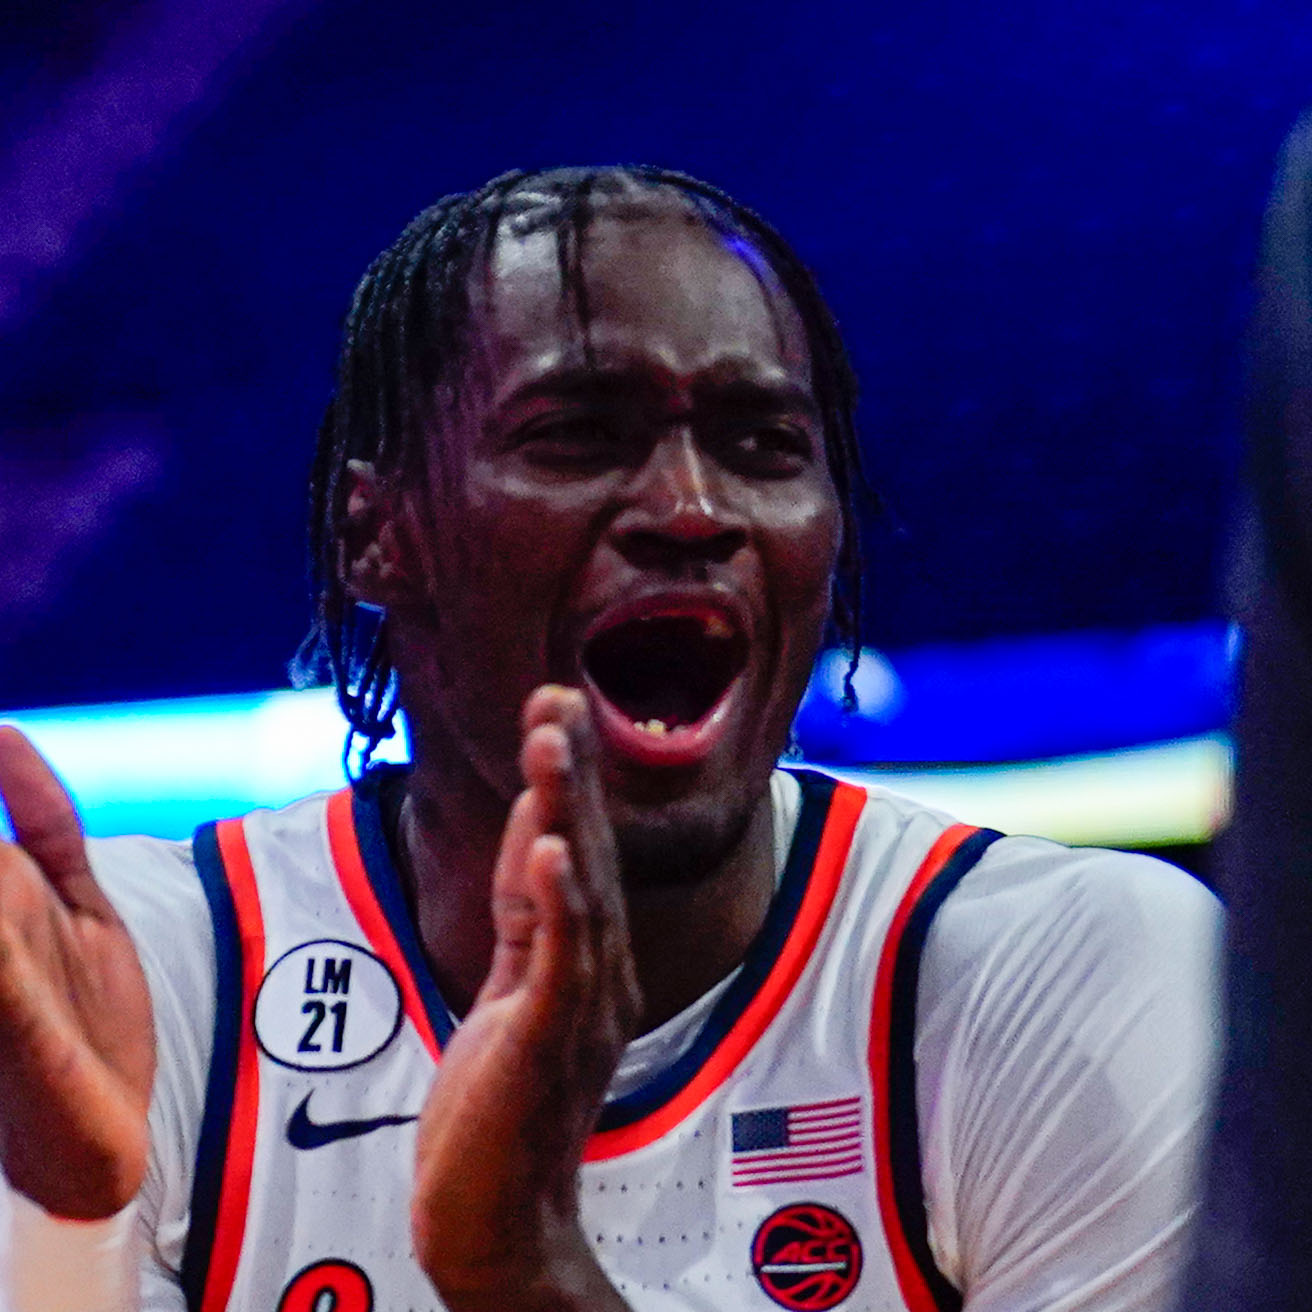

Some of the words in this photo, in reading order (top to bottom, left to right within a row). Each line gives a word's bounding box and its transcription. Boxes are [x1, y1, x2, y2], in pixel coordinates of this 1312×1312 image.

[304, 958, 352, 994] LM
[297, 1000, 347, 1053] 21
[770, 1239, 850, 1263] ACC
